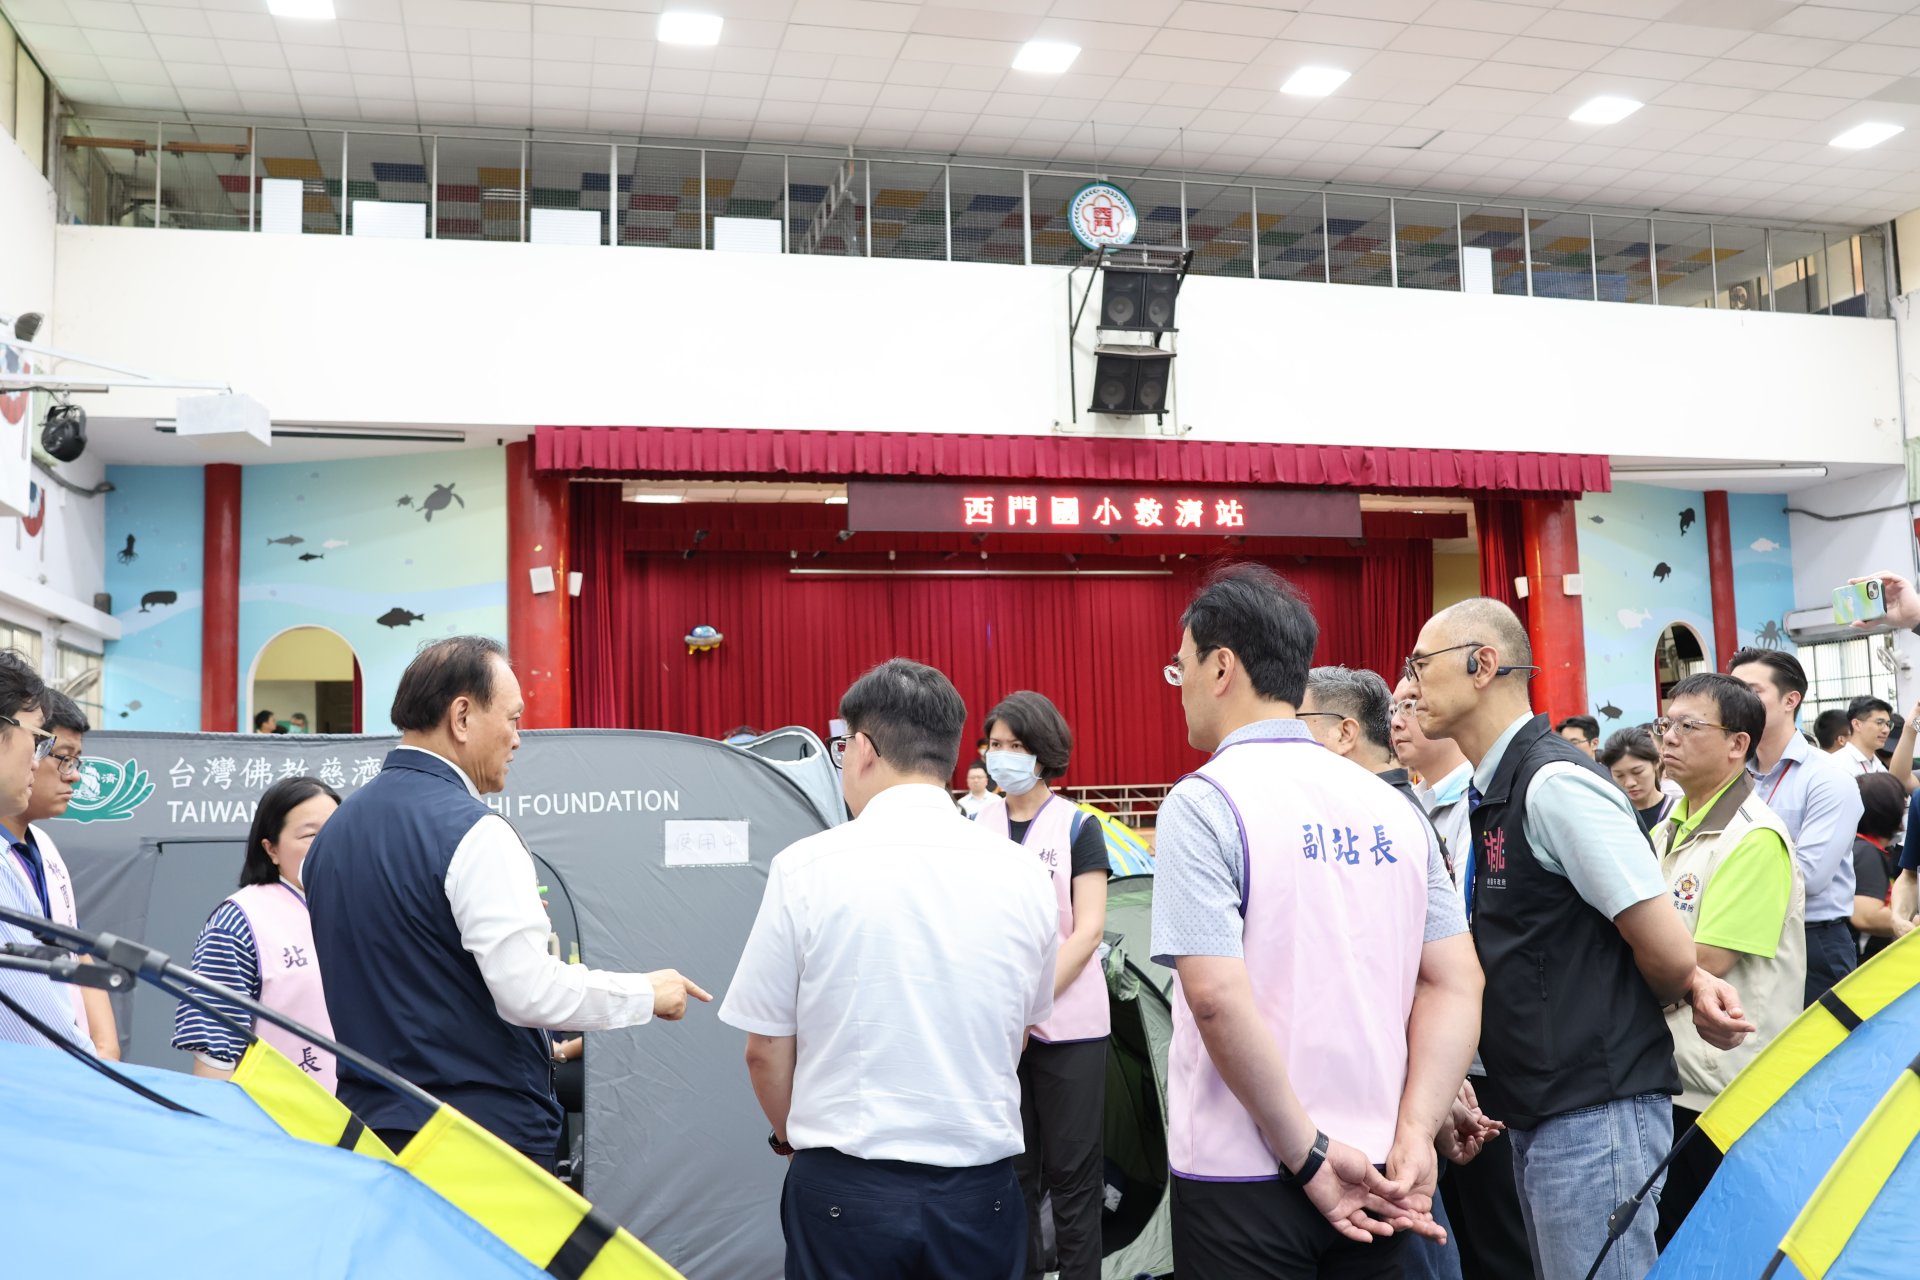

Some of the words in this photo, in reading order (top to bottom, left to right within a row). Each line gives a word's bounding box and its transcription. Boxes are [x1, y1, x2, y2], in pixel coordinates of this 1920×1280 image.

[963, 495, 1244, 527] 西門國小救濟站
[519, 790, 679, 816] FOUNDATION
[1302, 823, 1398, 866] 副站長
